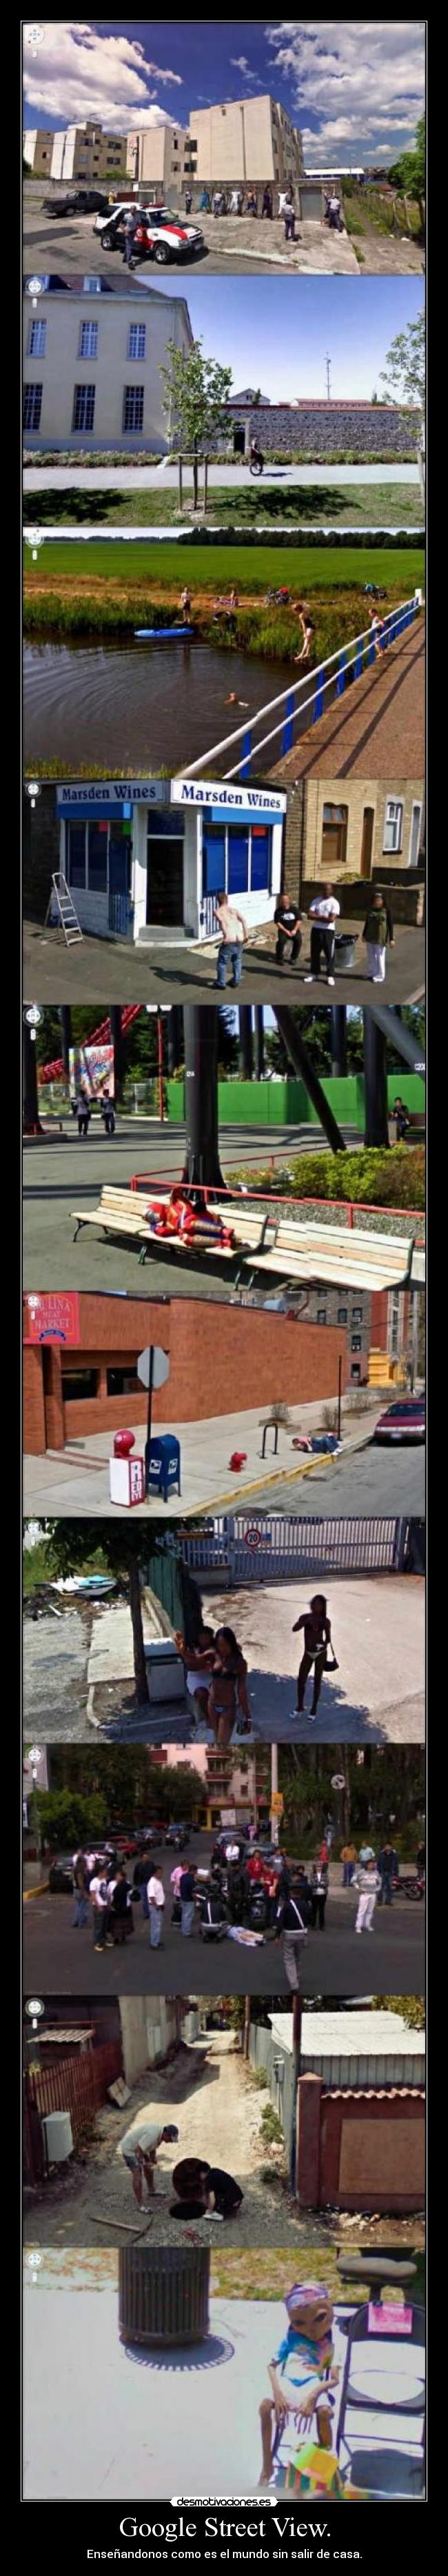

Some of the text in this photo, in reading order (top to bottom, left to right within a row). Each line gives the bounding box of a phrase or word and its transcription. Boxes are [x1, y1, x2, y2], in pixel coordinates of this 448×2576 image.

[62, 785, 156, 801] Marsden Wines
[181, 785, 281, 808] Marsden Wines
[34, 1318, 69, 1330] MARKET
[249, 1532, 258, 1543] 20
